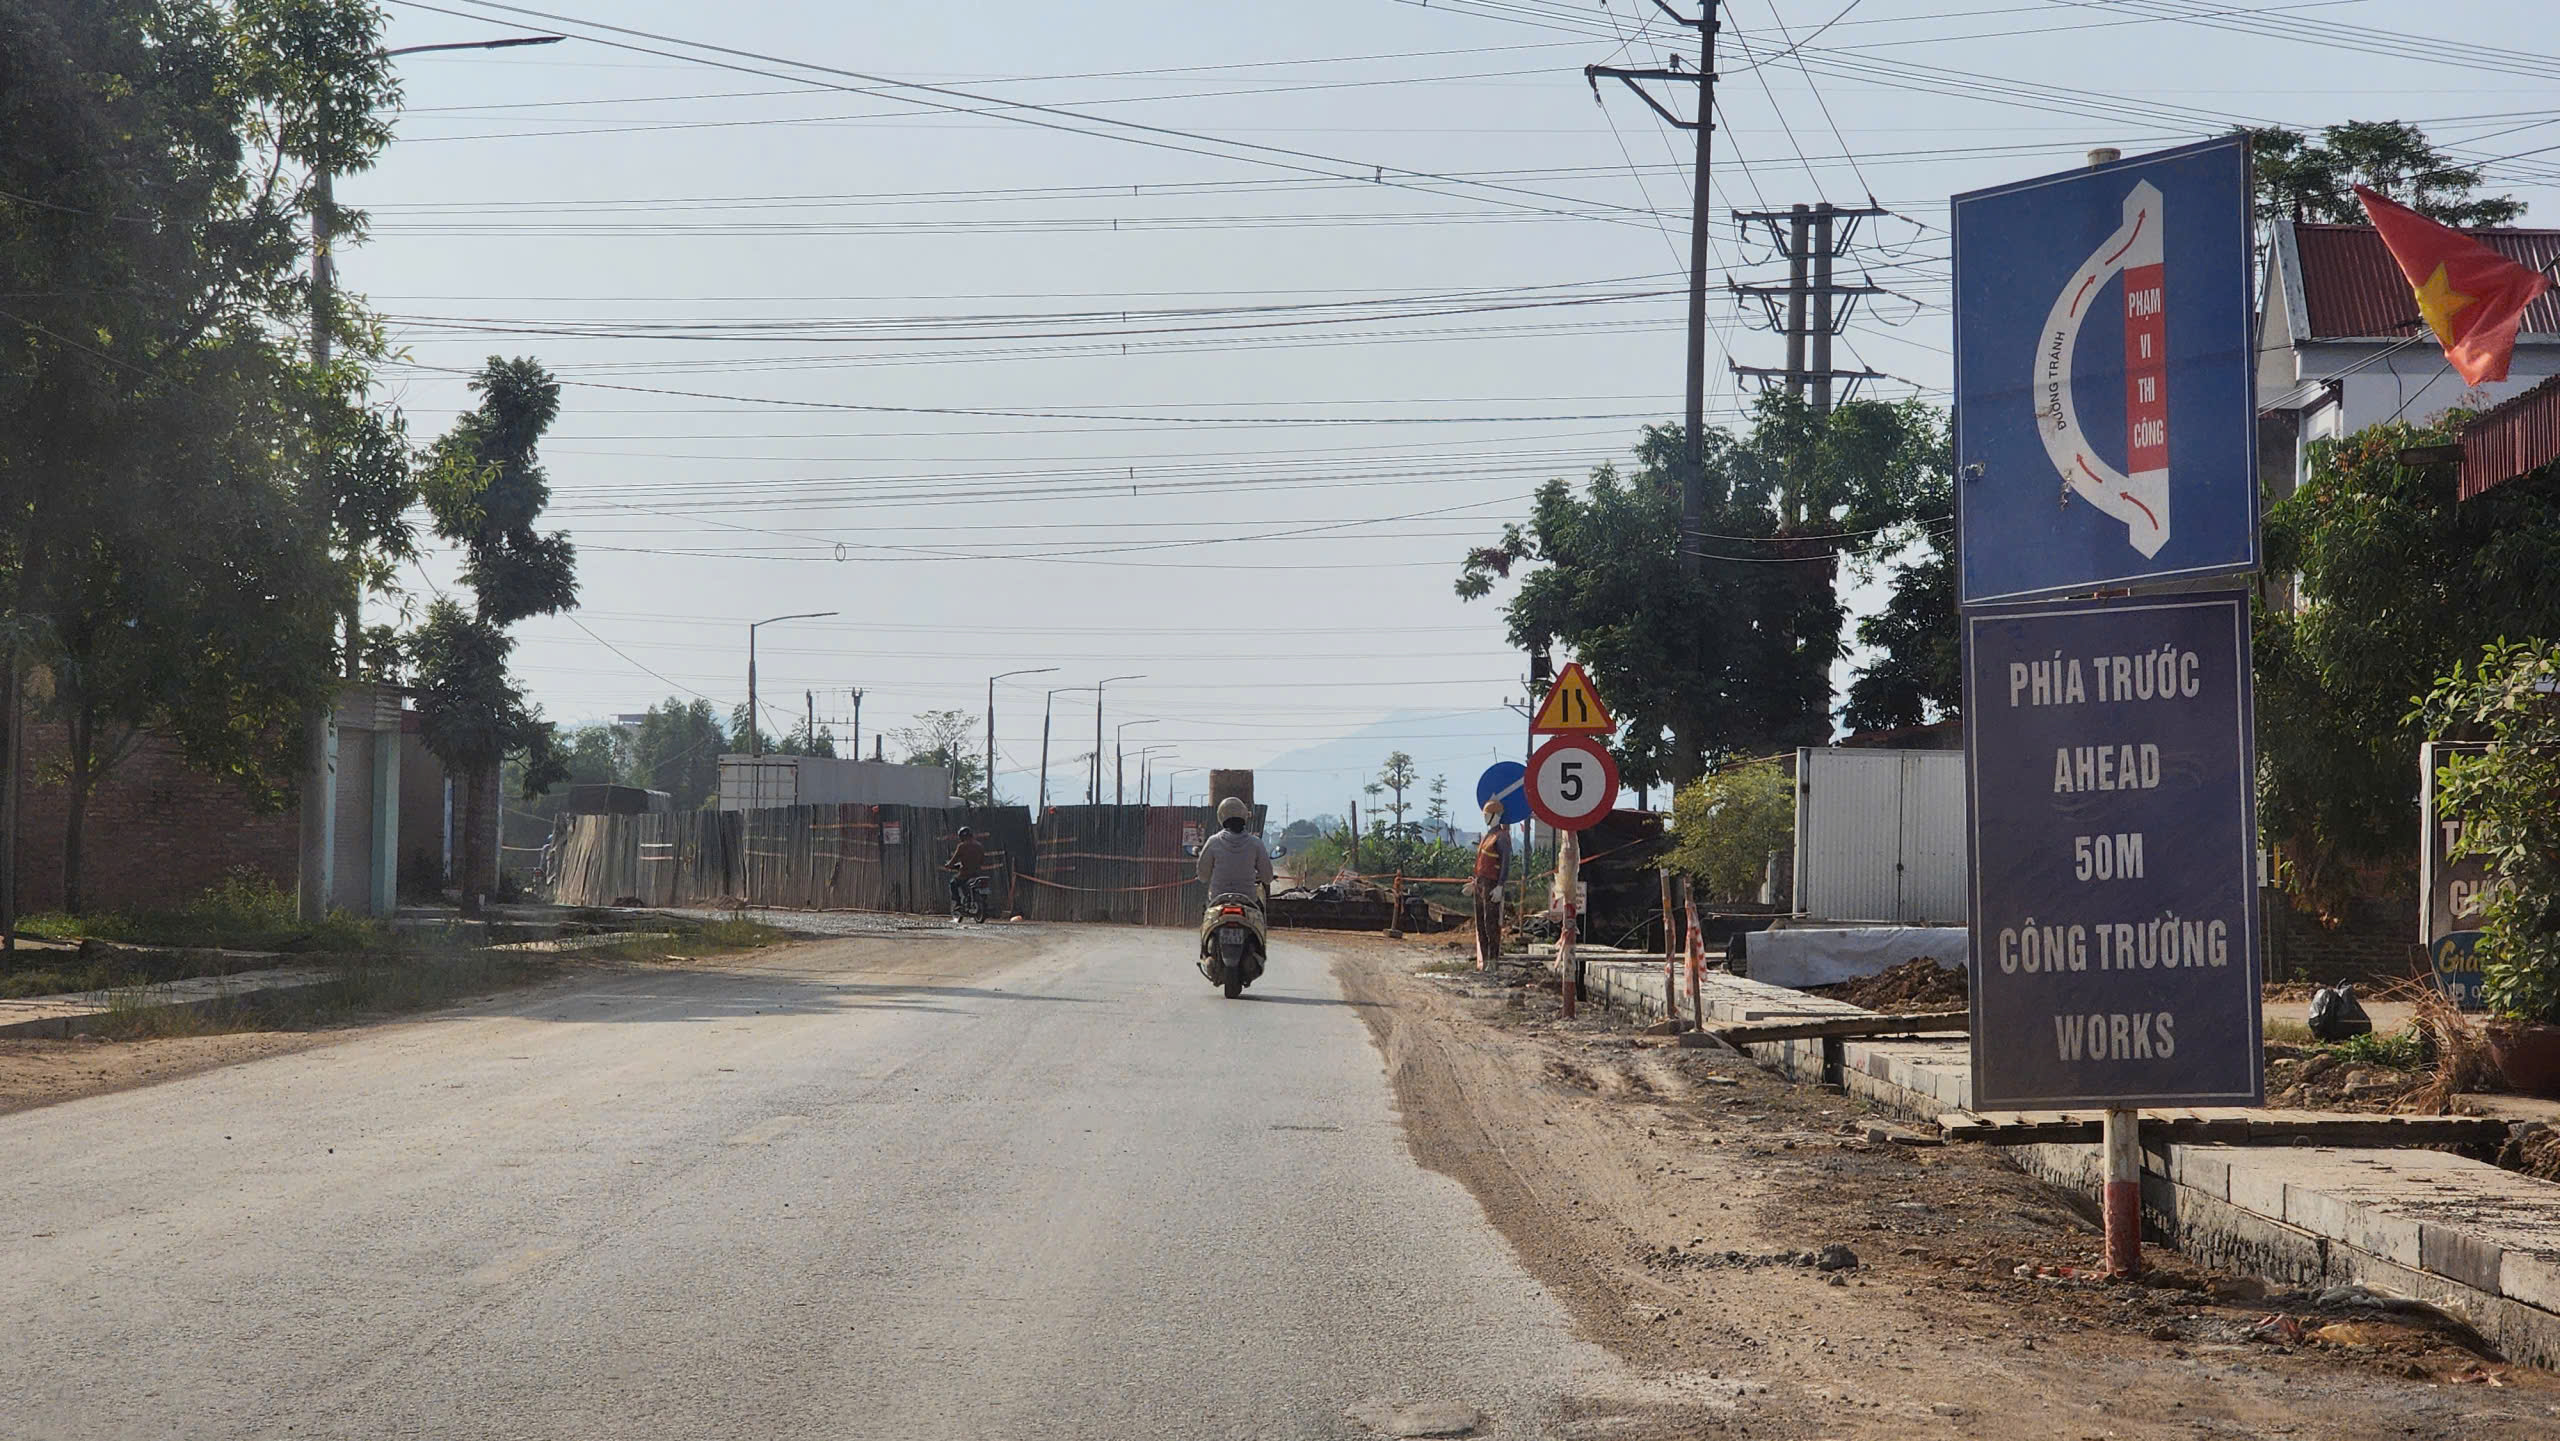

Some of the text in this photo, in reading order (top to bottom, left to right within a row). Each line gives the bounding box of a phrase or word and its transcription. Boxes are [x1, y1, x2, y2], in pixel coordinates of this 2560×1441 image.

[2128, 287, 2161, 321] PHẠM
[2048, 331, 2065, 379] TRÁNH
[2140, 333, 2151, 359] VI
[2138, 376, 2155, 403] THI
[2134, 417, 2164, 448] CÔNG
[2009, 643, 2200, 708] PHÍA TRƯỚC
[1560, 762, 1583, 801] 5
[2053, 743, 2160, 793] AHEAD
[2075, 833, 2144, 882] 50M
[1999, 910, 2228, 975] CÔNG TRƯỜNG
[2054, 1012, 2175, 1062] WORKS
